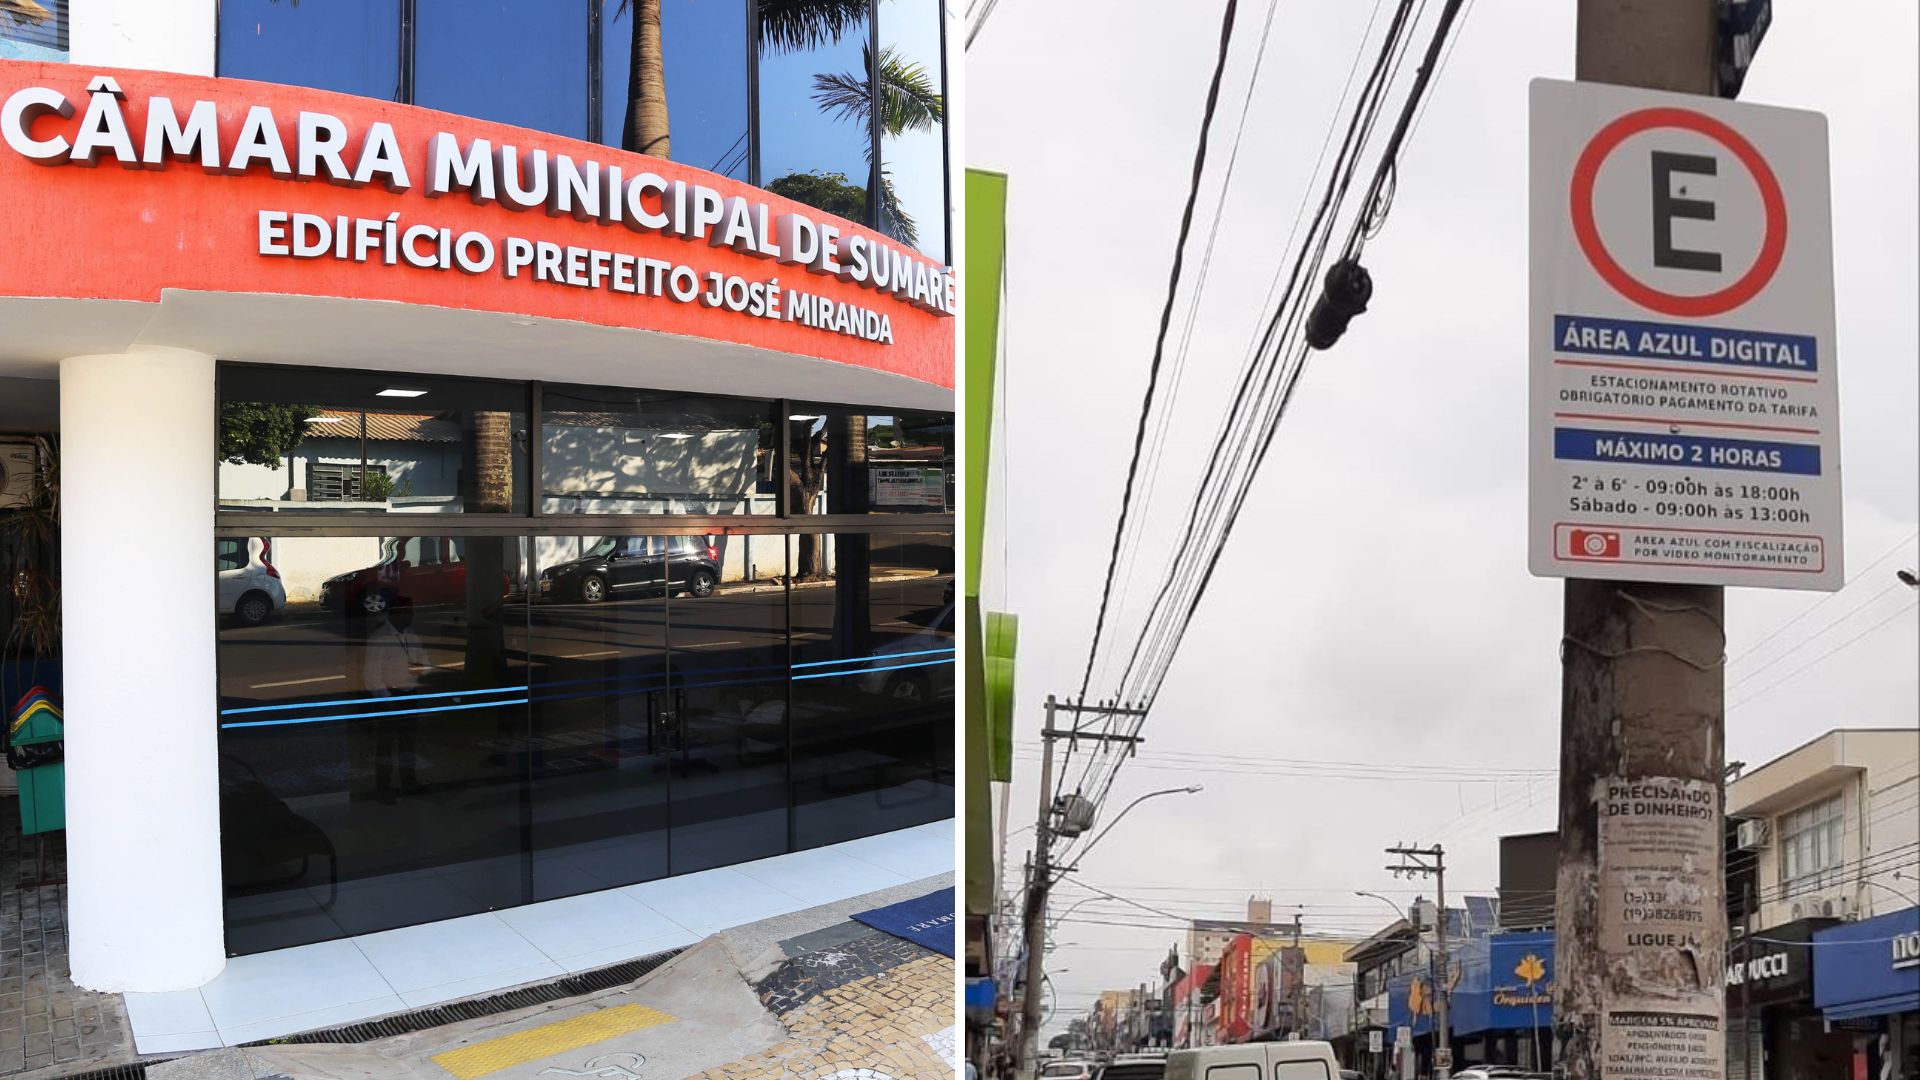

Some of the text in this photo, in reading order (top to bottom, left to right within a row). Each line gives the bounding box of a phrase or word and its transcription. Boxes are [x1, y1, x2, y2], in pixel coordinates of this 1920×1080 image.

[0, 75, 955, 317] CÂMARA MUNICIPAL DE SUMARÉ
[1650, 149, 1723, 274] E
[256, 209, 894, 345] EDIFÍCIO PREFEITO JOSÉ MIRANDA
[1563, 321, 1807, 365] ÁREA AZUL DIGITAL
[1590, 374, 1788, 399] ESTACIONAMENTO ROTATIVO
[1659, 396, 1744, 412] PAGAMENTO
[1748, 402, 1767, 414] DA
[1771, 403, 1818, 417] TARIFA
[1595, 437, 1782, 467] MÁXIMO 2 HORAS
[1646, 479, 1708, 496] 09:00h
[1740, 485, 1800, 502] 18:00h
[1570, 496, 1637, 514] Sábado
[1656, 501, 1718, 518] 09:00h
[1750, 506, 1810, 523] 13:00h
[1670, 536, 1700, 547] AZUL
[1704, 538, 1730, 549] COM
[1634, 547, 1658, 557] POR
[1704, 551, 1808, 565] MONITORAMENTO
[1608, 803, 1631, 816] DE
[1627, 933, 1675, 947] LIGUE
